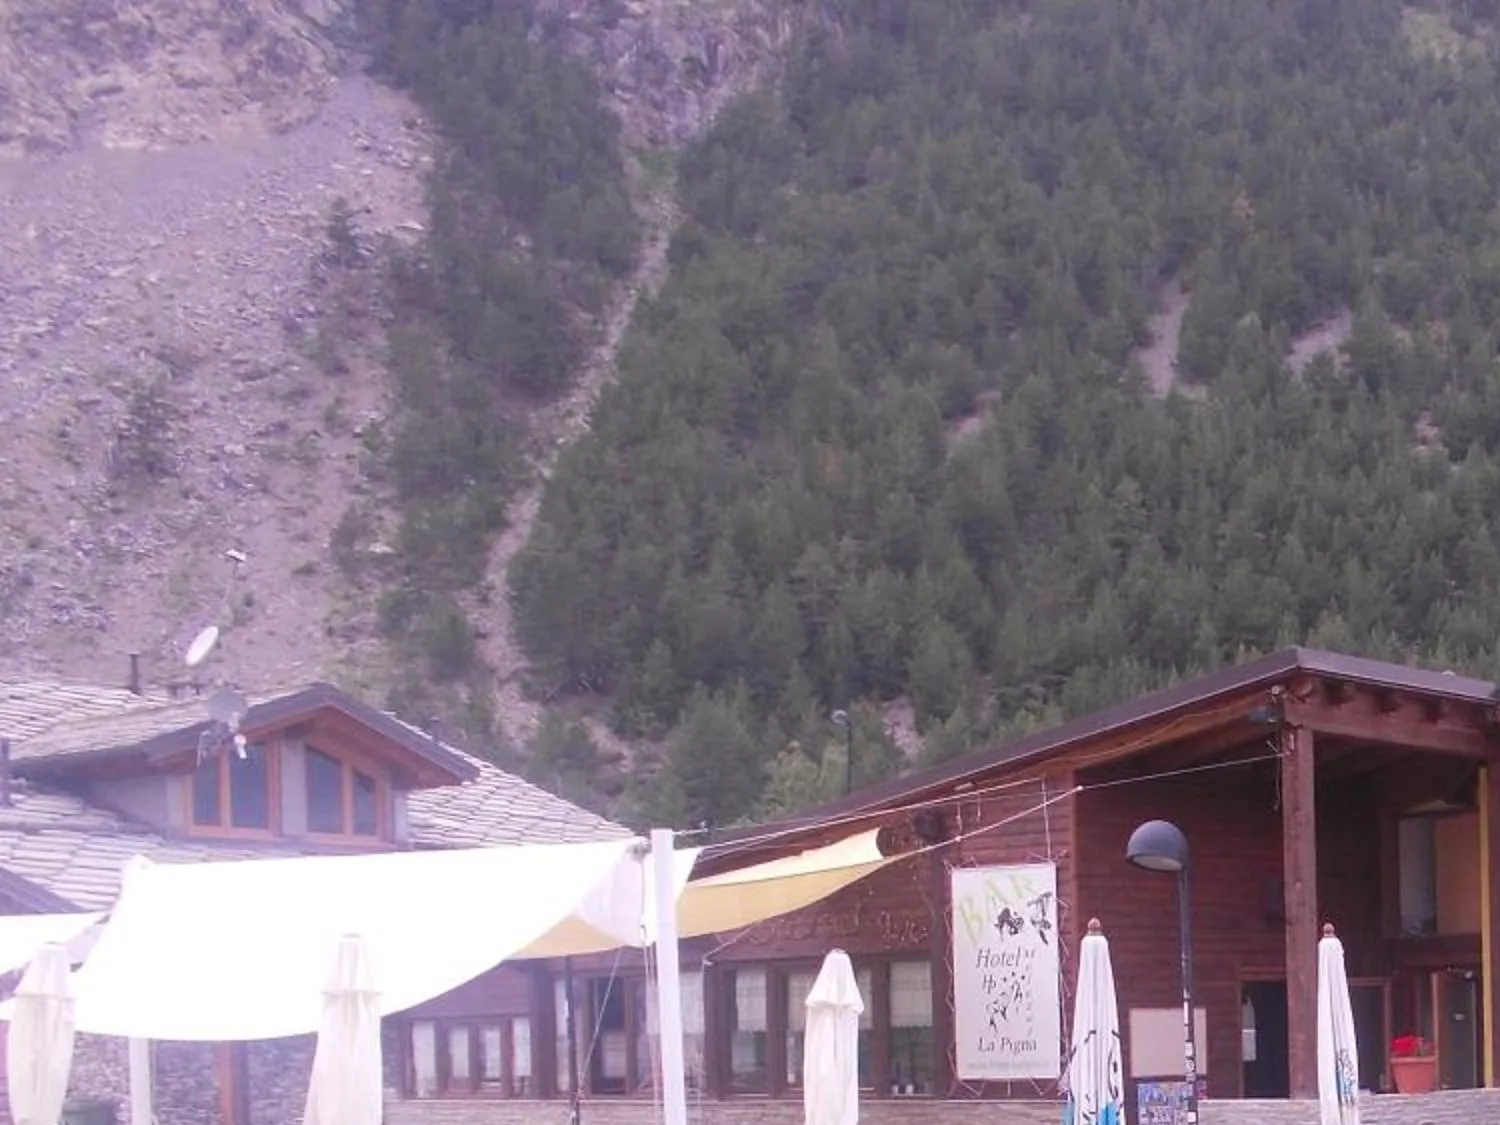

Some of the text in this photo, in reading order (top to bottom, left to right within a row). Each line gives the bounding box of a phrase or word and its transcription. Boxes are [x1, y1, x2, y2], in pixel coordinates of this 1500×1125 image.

[976, 946, 1020, 968] Hotel
[977, 1036, 1038, 1056] La Pigna
